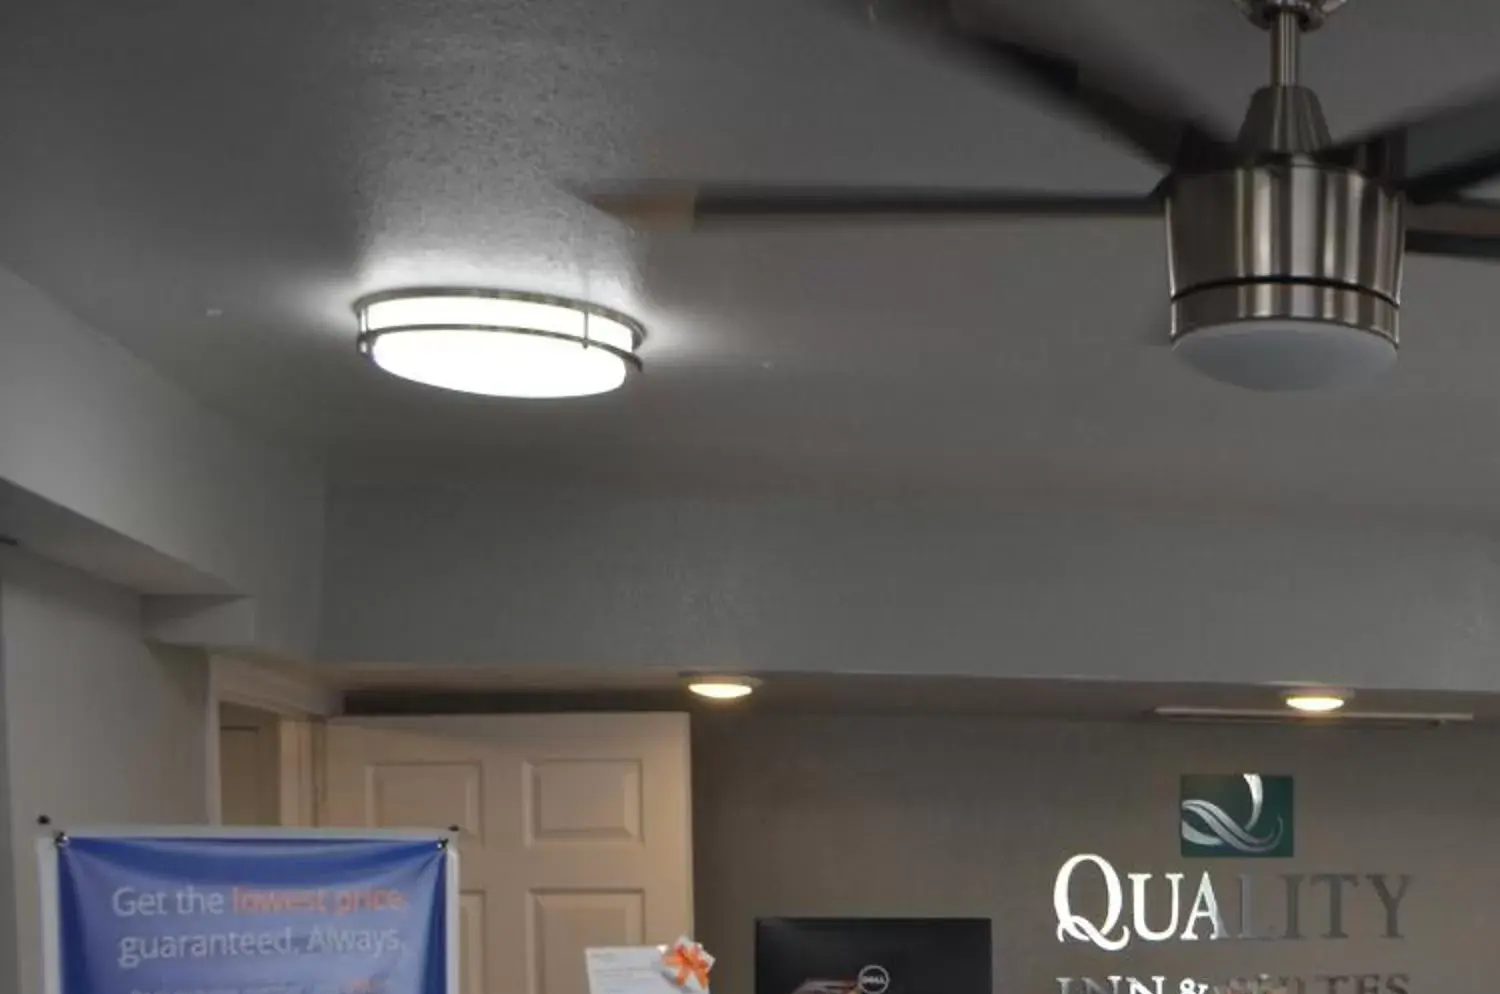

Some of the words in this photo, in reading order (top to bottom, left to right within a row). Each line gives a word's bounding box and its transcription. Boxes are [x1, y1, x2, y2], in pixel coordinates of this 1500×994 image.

[112, 885, 168, 917] Get
[176, 885, 225, 916] the
[231, 885, 327, 915] lowest
[1053, 853, 1413, 951] QUALITY
